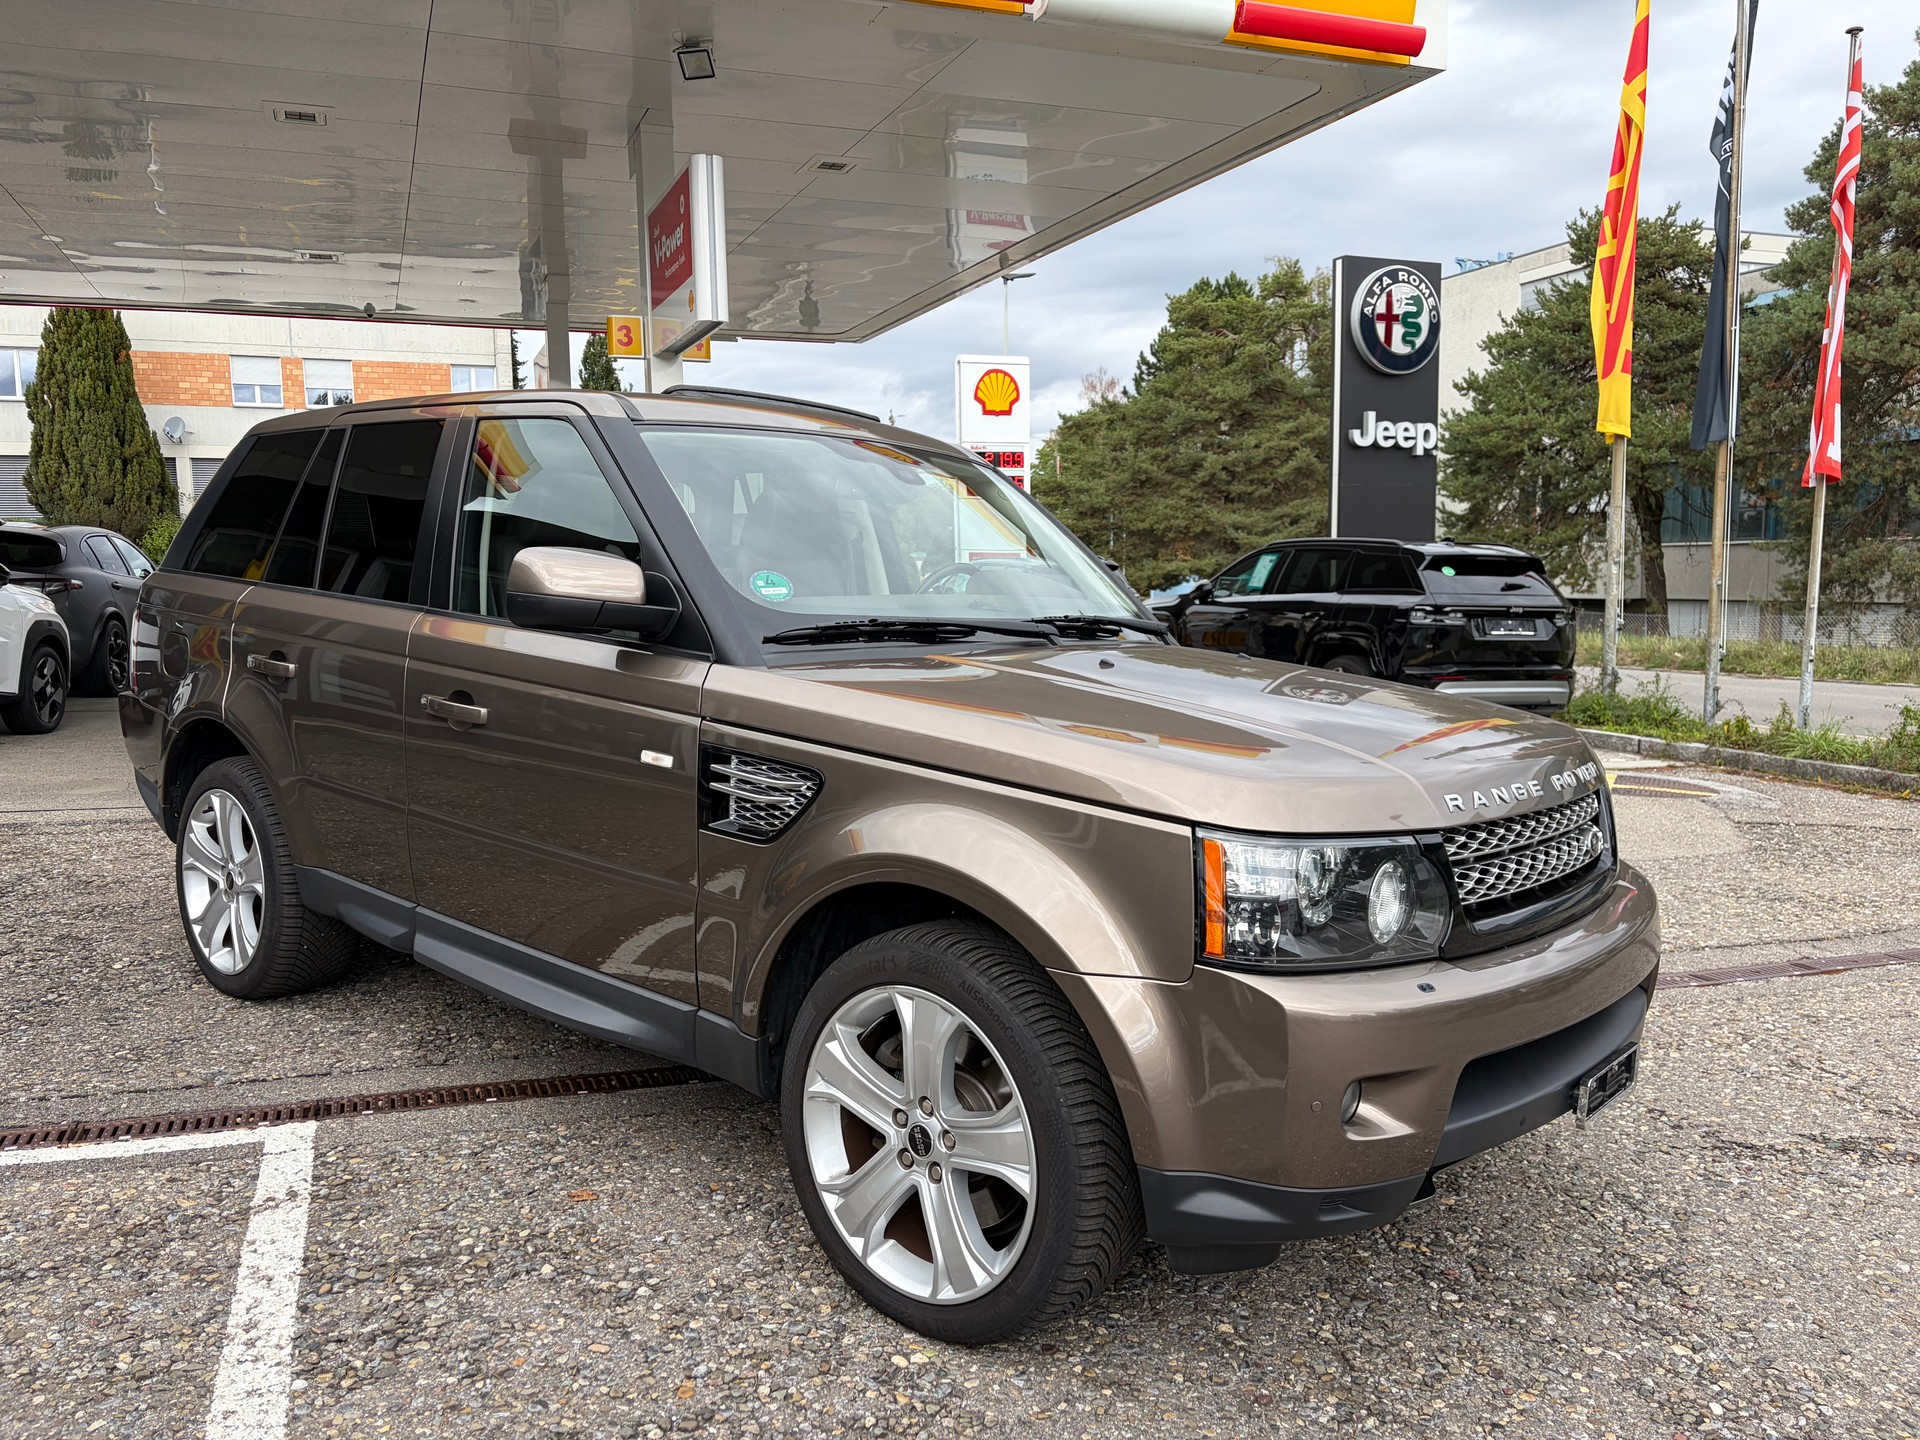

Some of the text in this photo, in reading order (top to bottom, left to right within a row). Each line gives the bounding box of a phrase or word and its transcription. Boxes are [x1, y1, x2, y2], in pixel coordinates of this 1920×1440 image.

[654, 221, 684, 268] V-Power
[1363, 271, 1438, 324] ALFA ROMEO
[616, 324, 634, 347] 3
[1348, 411, 1437, 456] Jeep
[1443, 761, 1600, 814] RANGE ROVER
[957, 979, 1036, 1077] AllSeasonContact
